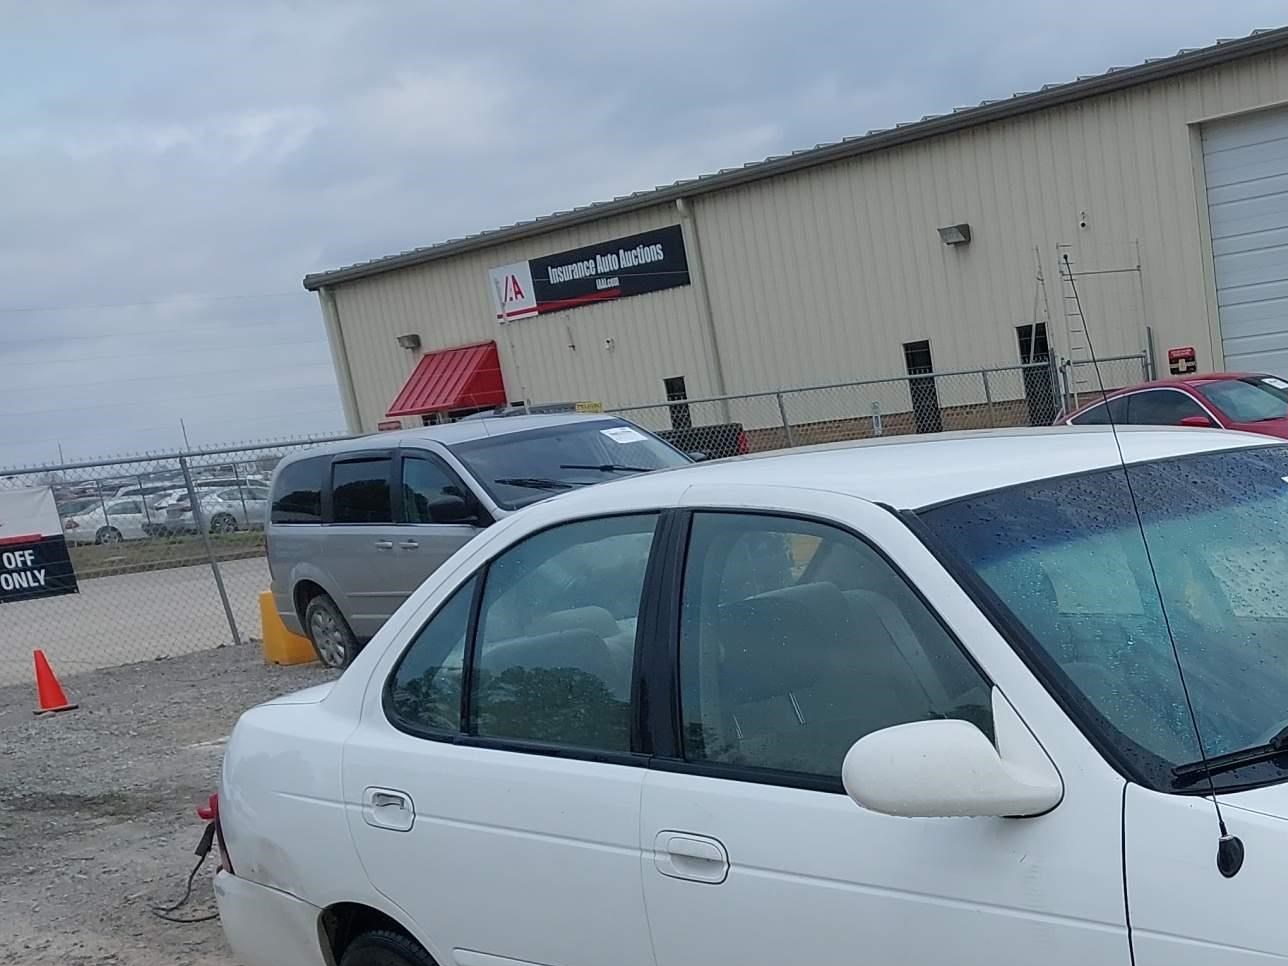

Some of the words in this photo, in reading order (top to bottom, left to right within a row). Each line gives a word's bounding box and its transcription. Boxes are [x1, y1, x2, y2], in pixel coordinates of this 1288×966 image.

[547, 259, 596, 285] Insurance
[596, 253, 619, 274] Auto
[619, 243, 664, 268] Auctions
[2, 549, 35, 569] OFF
[0, 568, 46, 590] ONLY
